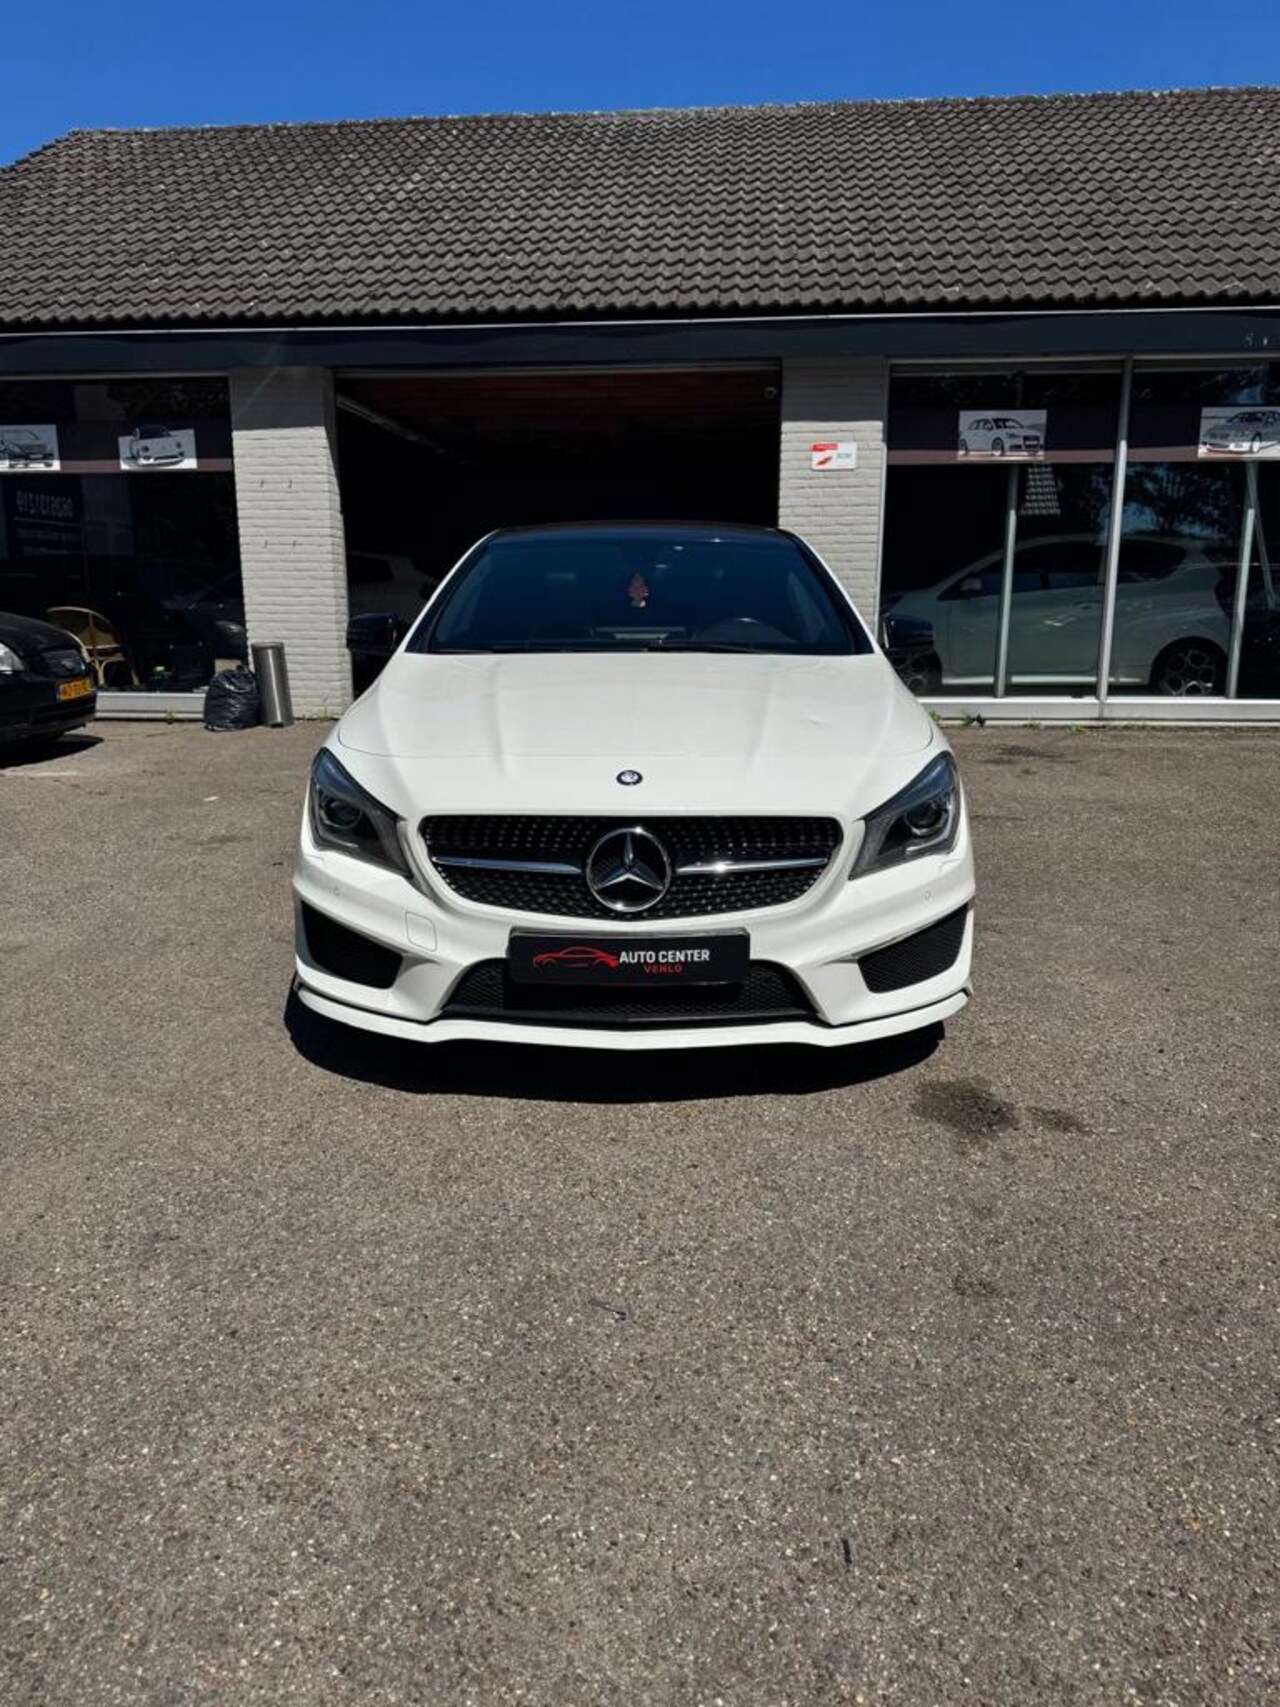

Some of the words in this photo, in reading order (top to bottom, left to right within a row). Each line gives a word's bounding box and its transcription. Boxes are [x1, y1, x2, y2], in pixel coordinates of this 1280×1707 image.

[619, 950, 656, 964] AUTO
[658, 949, 710, 963] CENTER
[643, 964, 683, 973] VENLO
